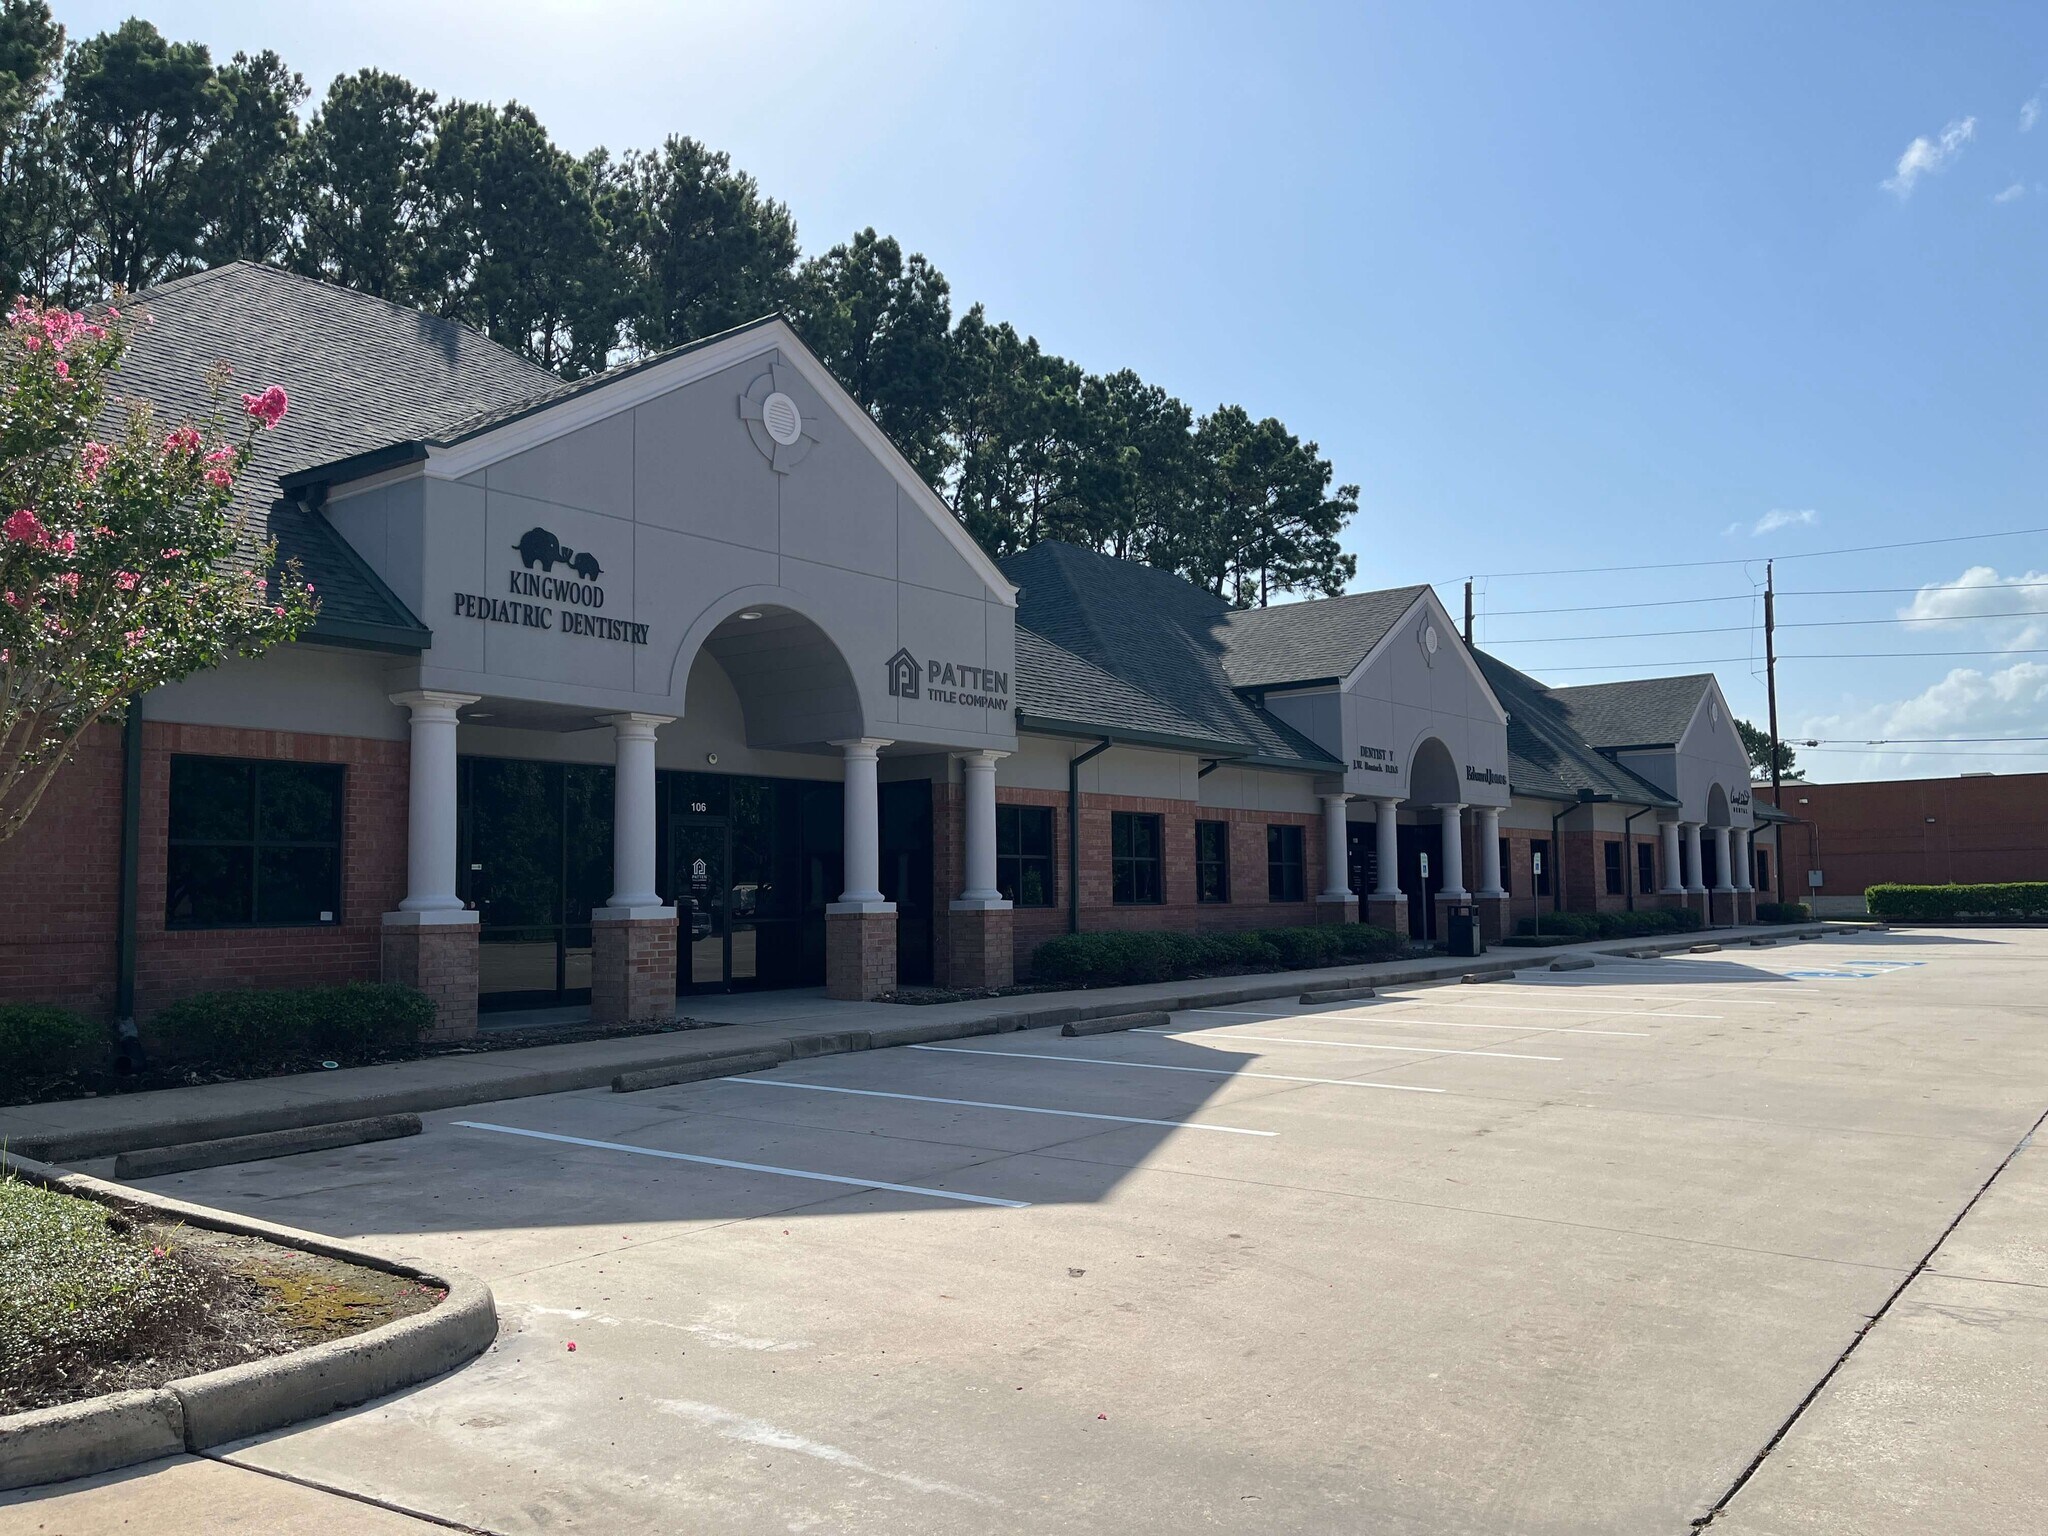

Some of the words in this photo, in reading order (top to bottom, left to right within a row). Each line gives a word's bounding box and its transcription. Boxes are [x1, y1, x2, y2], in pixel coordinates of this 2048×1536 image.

[510, 570, 604, 608] KINGWOOD
[454, 592, 552, 630] PEDIATRIC
[561, 610, 650, 645] DENTISTRY
[928, 660, 1008, 694] PATTEN
[927, 688, 957, 704] TITLE
[959, 693, 1008, 711] COMPANY
[691, 802, 706, 812] 106
